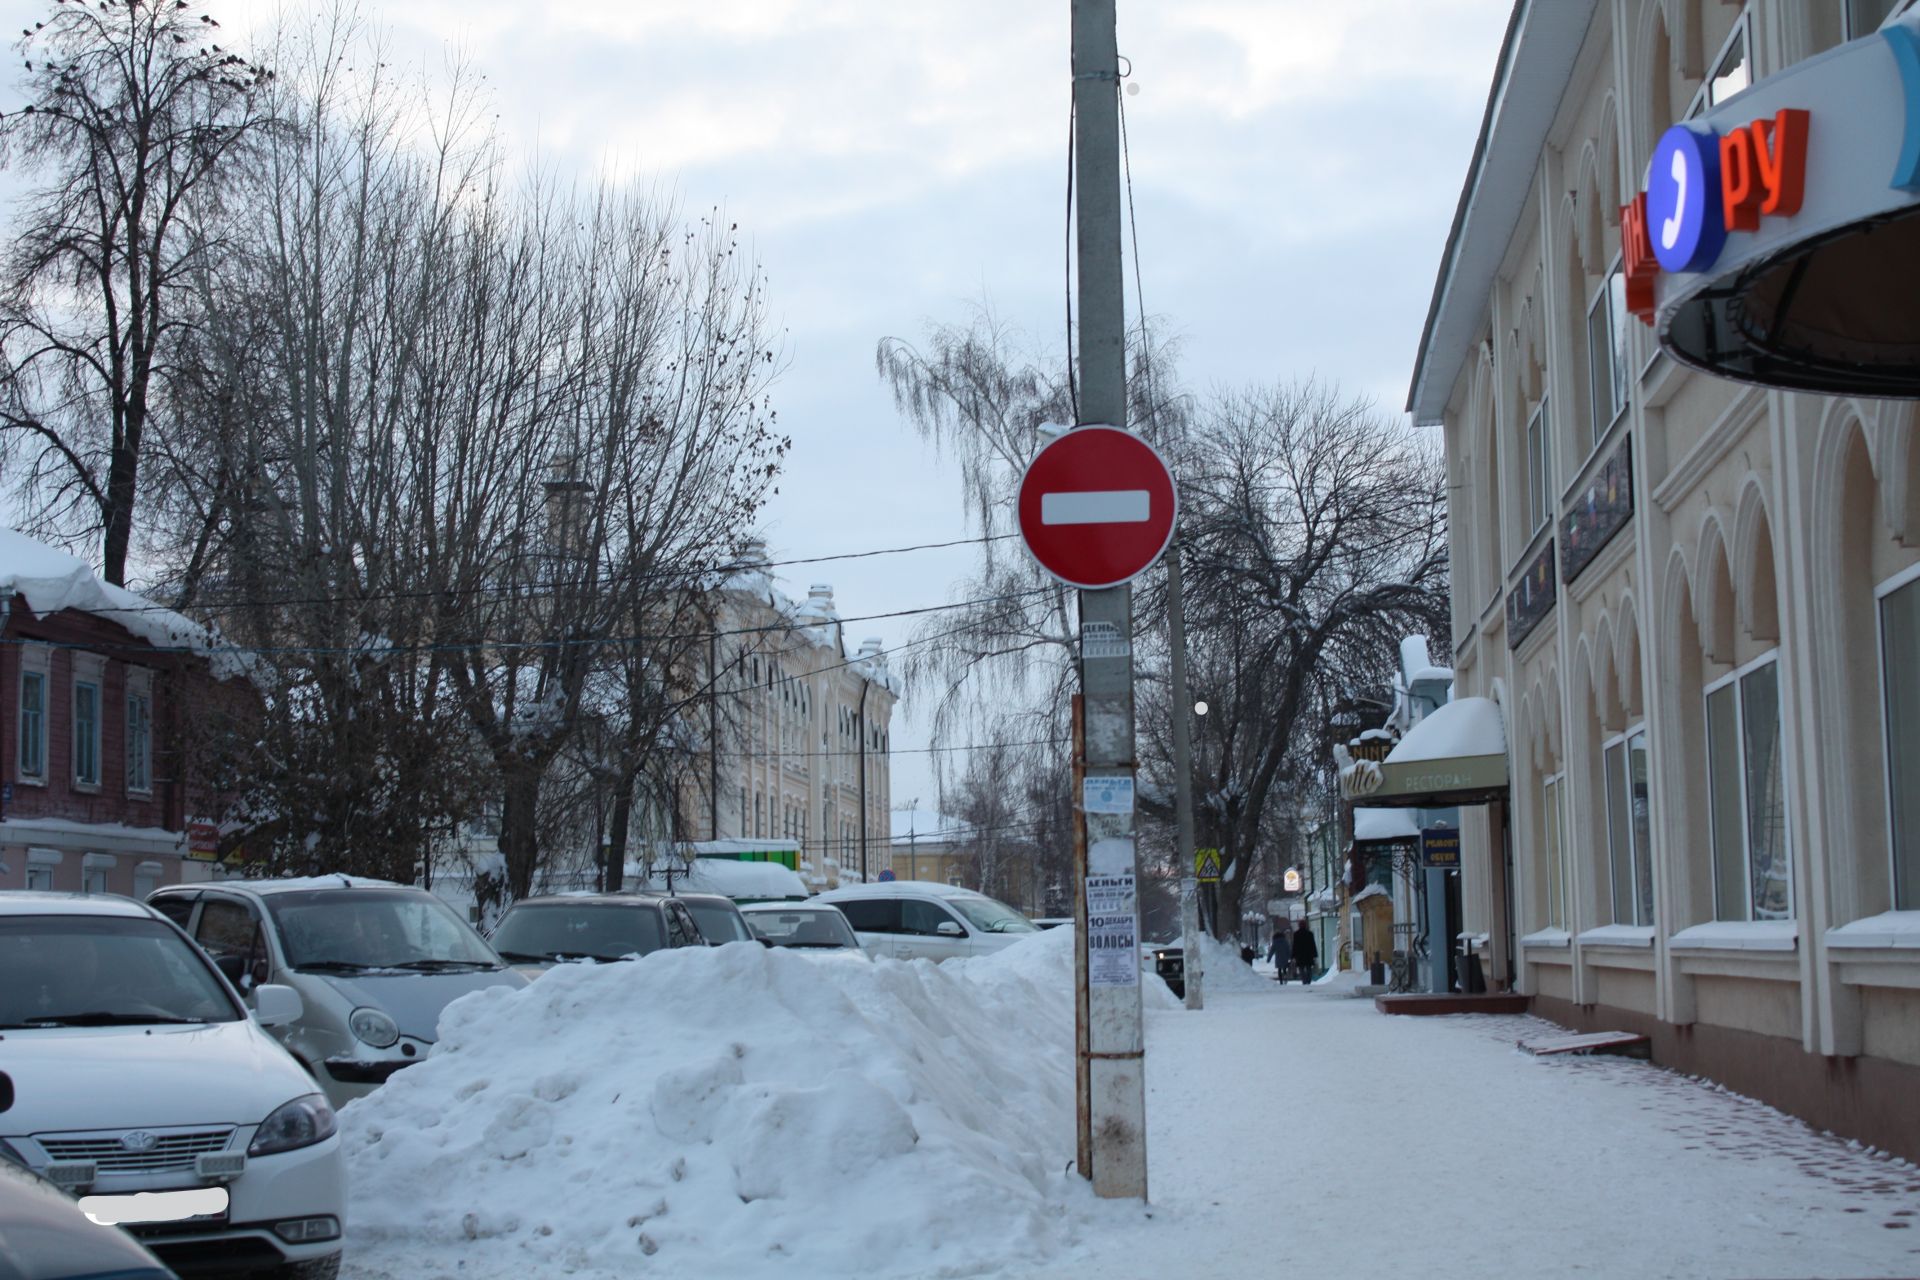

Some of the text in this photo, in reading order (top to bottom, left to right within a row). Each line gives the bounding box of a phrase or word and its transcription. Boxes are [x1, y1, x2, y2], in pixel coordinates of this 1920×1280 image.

[1406, 773, 1473, 791] РЕСТОРАН
[1088, 878, 1133, 887] ДЕНЬГИ
[1089, 917, 1105, 928] 10
[1089, 934, 1134, 949] ВОЛОСЫ
